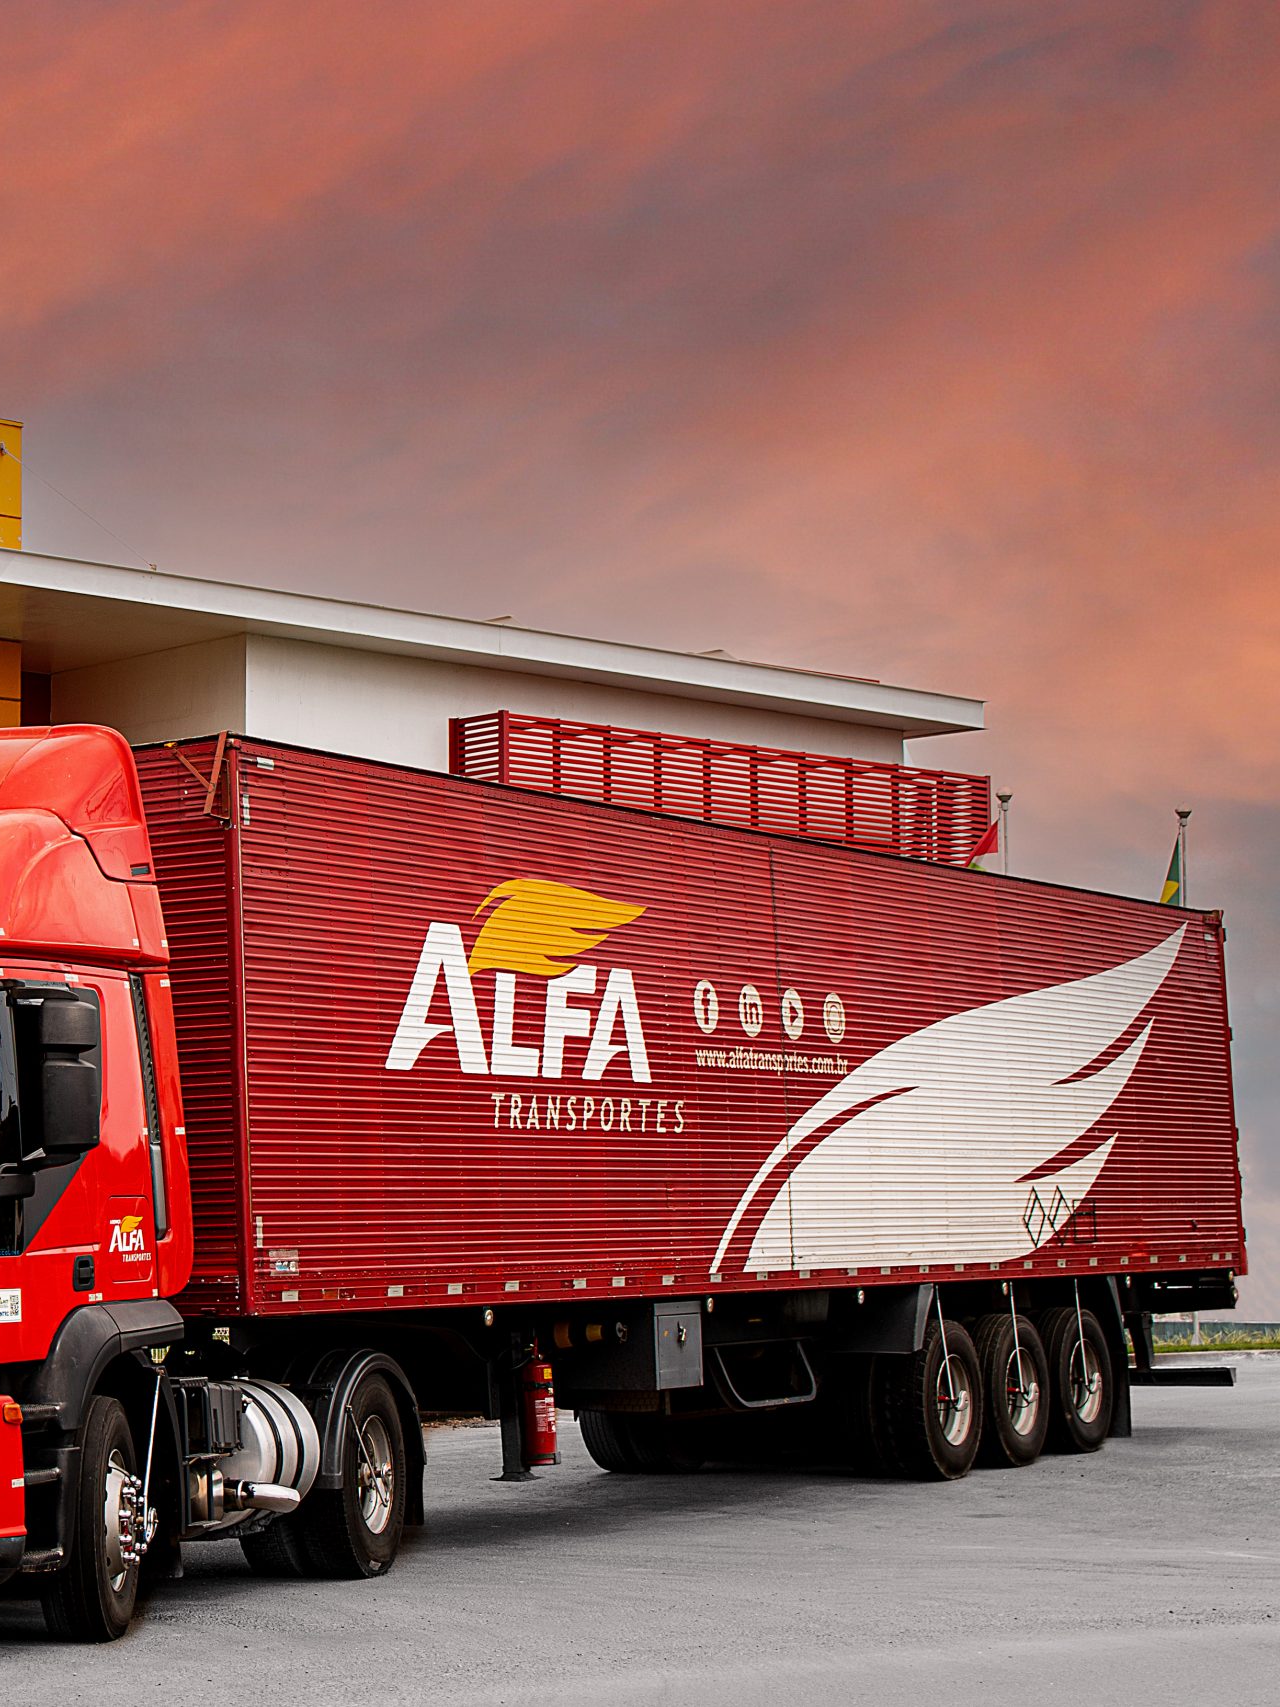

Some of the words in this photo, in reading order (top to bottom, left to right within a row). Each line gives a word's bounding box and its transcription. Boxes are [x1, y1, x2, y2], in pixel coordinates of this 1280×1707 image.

[384, 921, 653, 1084] ALFA
[695, 1046, 849, 1077] www.alfatransportes.com.br
[491, 1092, 685, 1134] TRANSPORTES
[108, 1223, 145, 1253] ALFA
[122, 1252, 152, 1263] TRANSPORTES
